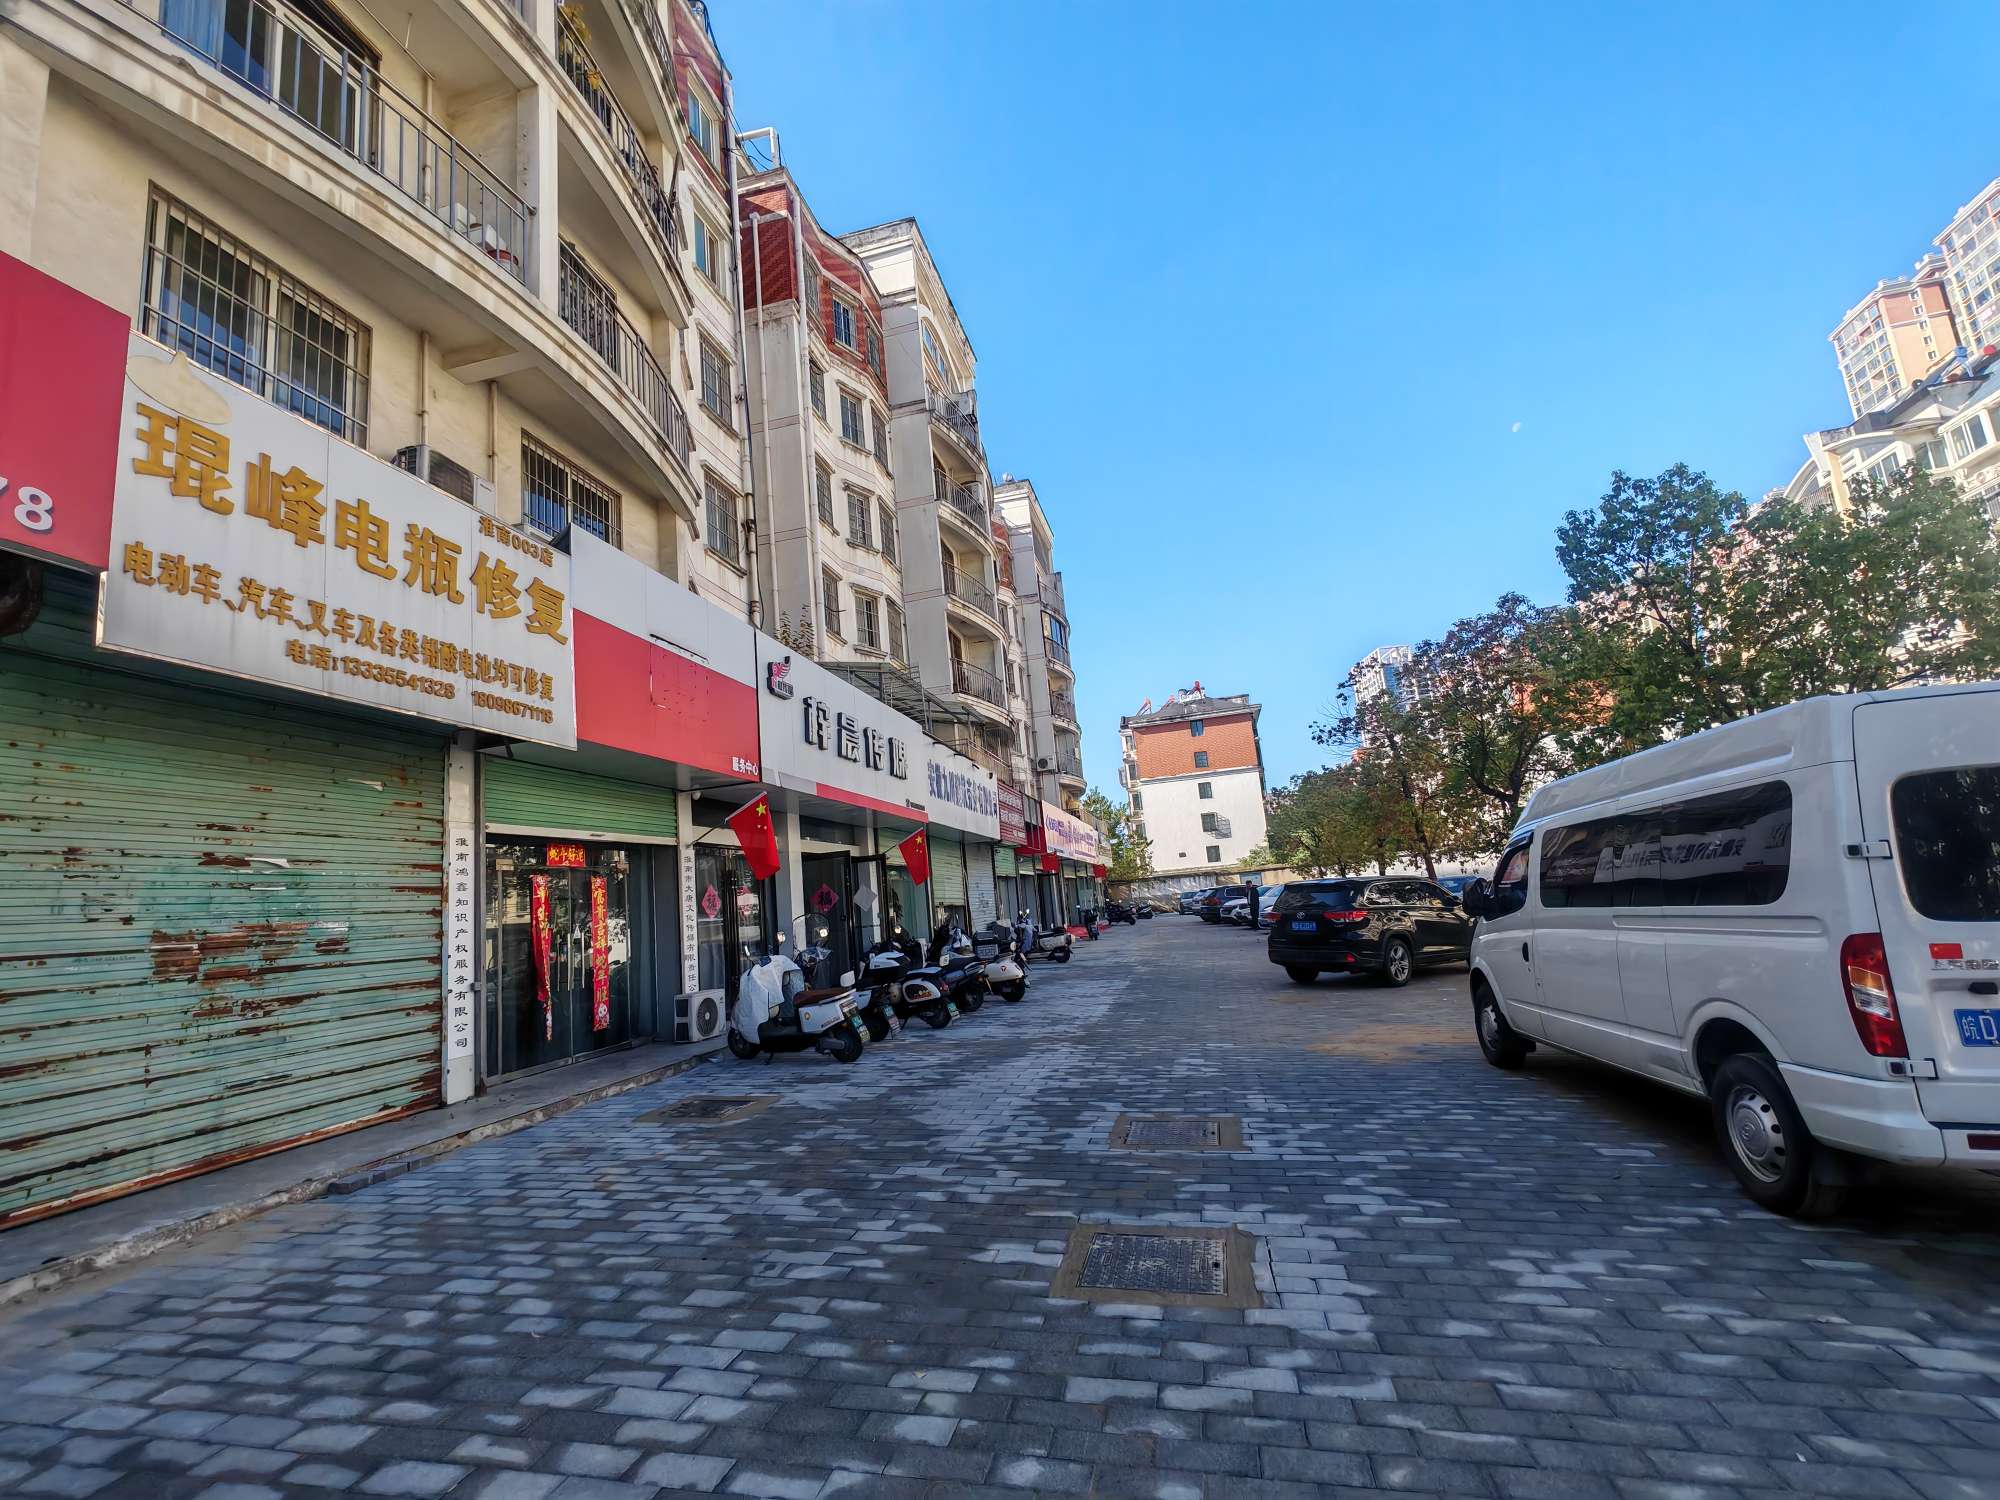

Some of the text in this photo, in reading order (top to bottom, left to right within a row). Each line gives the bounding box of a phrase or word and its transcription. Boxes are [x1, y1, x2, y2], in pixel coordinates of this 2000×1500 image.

[132, 402, 569, 645] 琨峰电瓶修复
[479, 515, 554, 567] 淮南003店
[123, 541, 555, 701] 电动车、汽车、叉车及各类铅酸电池均可修复
[732, 756, 759, 776] 服务中心
[454, 837, 469, 1048] 淮南鸿鑫知识产权服务有限公司
